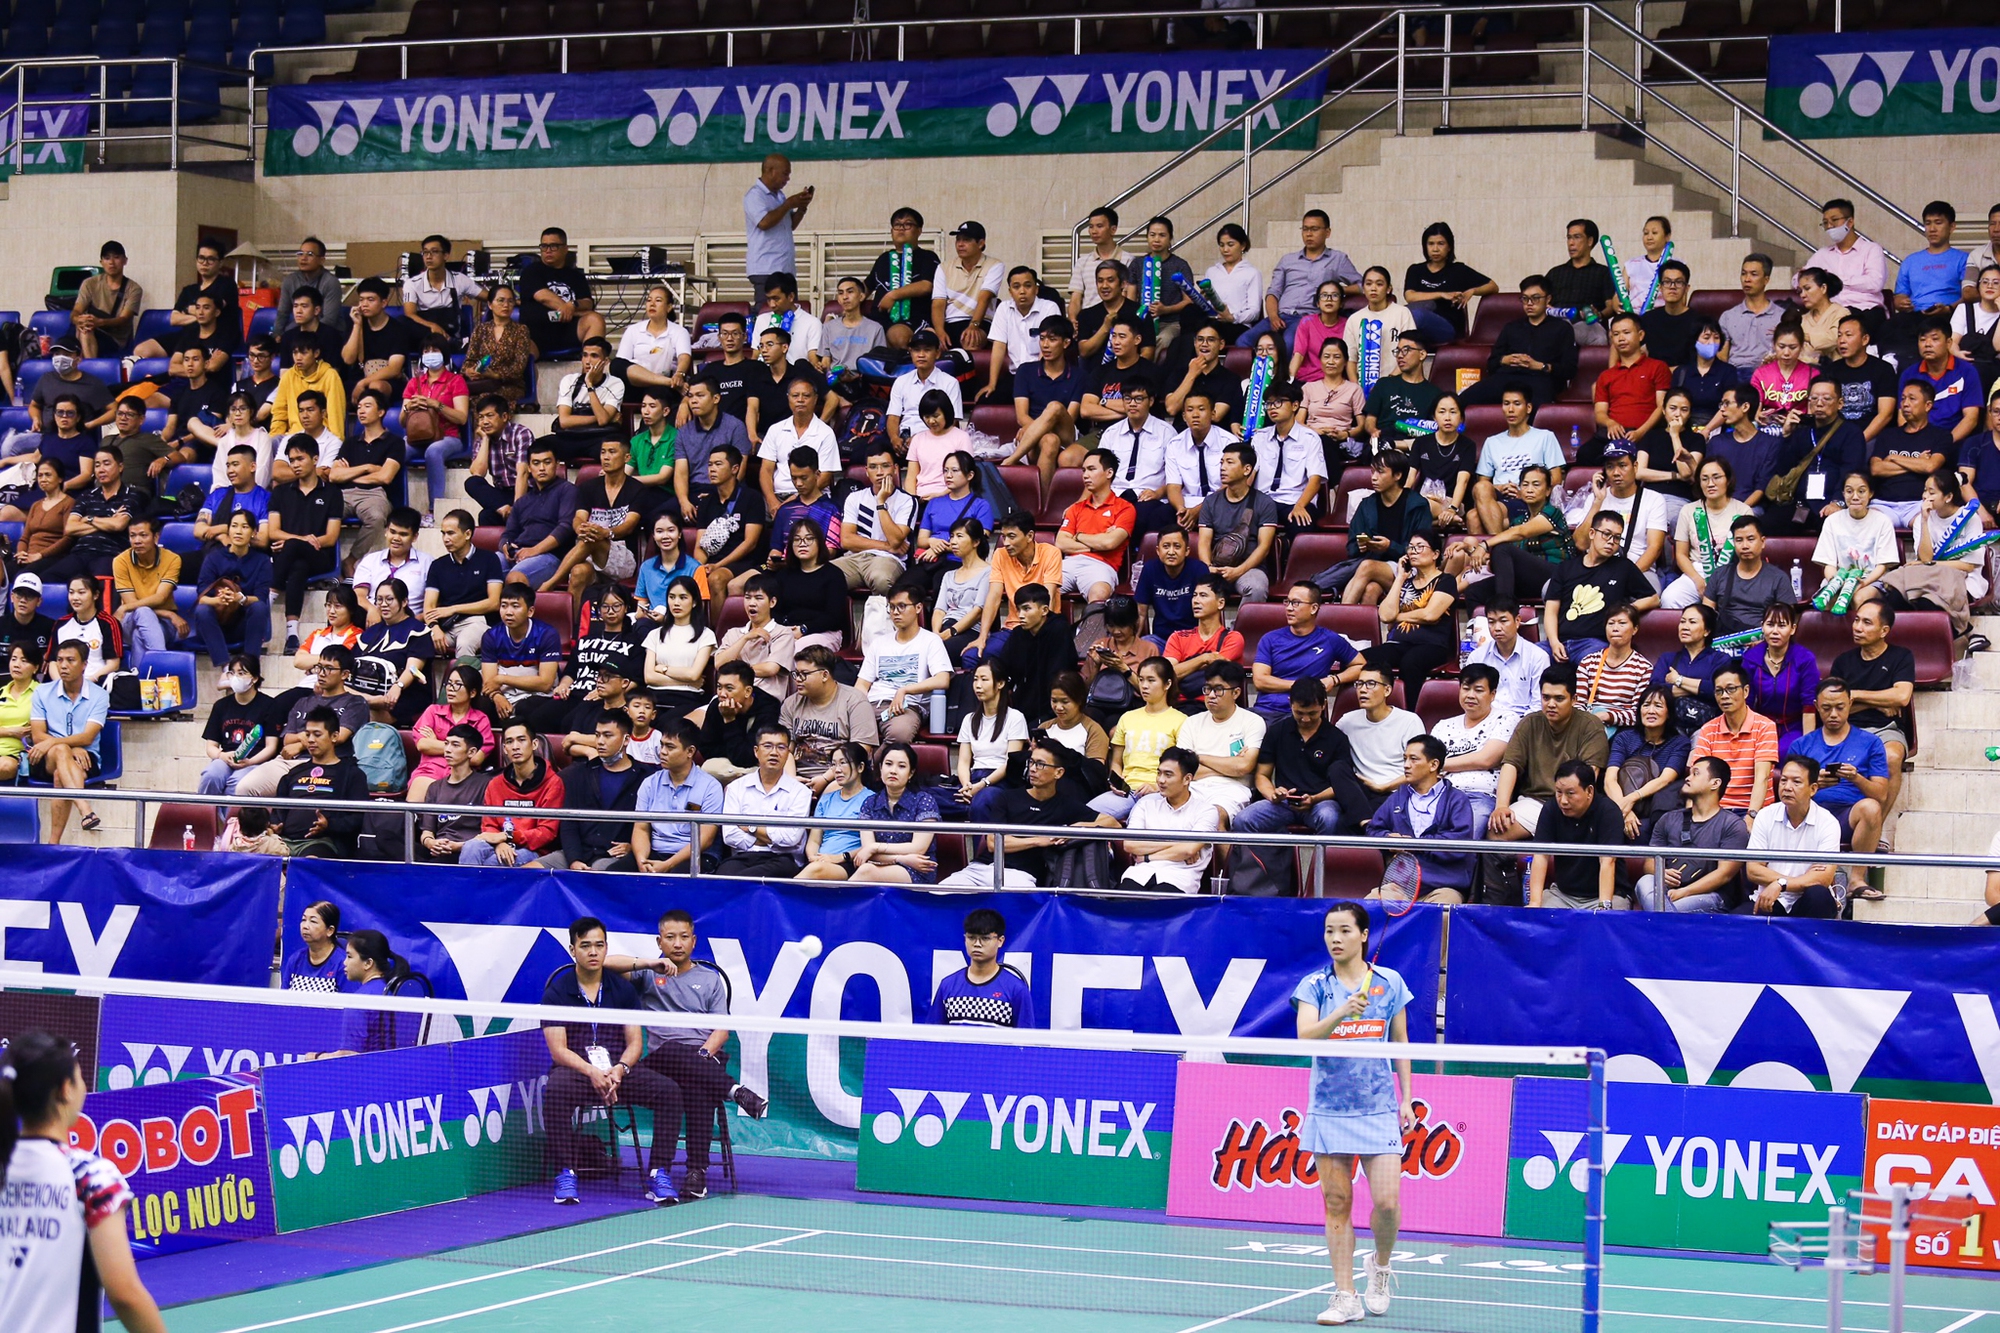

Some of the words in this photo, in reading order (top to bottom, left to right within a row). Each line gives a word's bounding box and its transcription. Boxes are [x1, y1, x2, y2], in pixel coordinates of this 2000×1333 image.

[394, 92, 556, 154] YONEX
[736, 81, 909, 144] YONEX
[1101, 69, 1287, 134] YONEX
[1369, 347, 1381, 385] YONEX
[342, 1094, 450, 1166] YONEX
[982, 1092, 1157, 1160] YONEX
[1877, 1119, 1919, 1140] DÂY
[1922, 1122, 1966, 1143] CÁP
[1644, 1135, 1841, 1205] YONEX
[1873, 1153, 1997, 1206] CA
[131, 1190, 181, 1245] LỌC
[187, 1173, 256, 1230] NƯỚC
[1915, 1231, 1951, 1256] SỐ
[1959, 1214, 1984, 1257] 1
